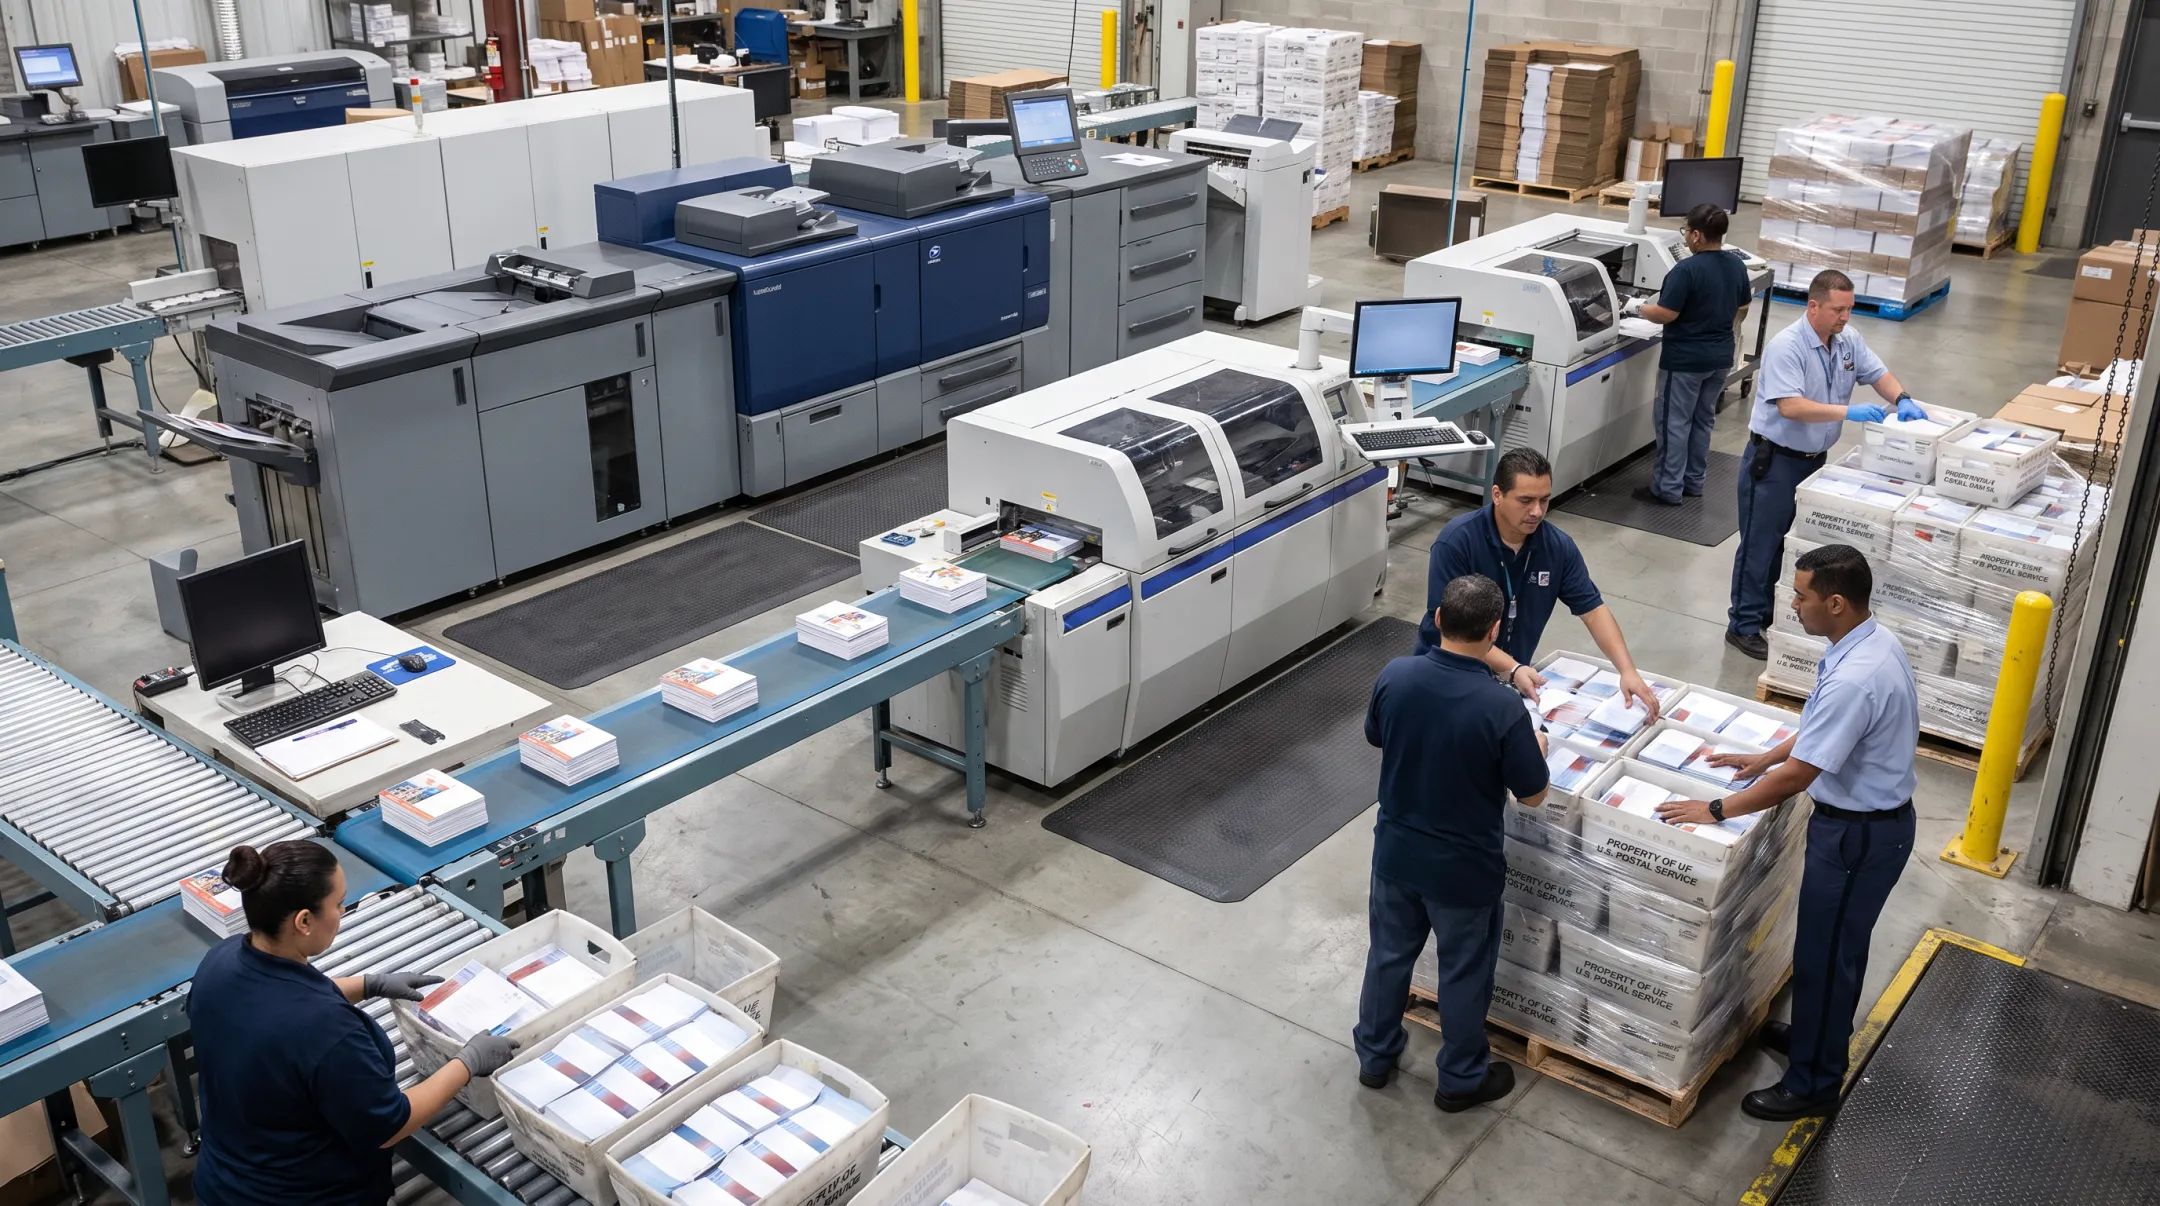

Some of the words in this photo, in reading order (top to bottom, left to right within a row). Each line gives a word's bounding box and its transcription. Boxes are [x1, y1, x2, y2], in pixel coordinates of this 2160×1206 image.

[1596, 844, 1613, 857] U.S.
[1615, 852, 1653, 871] POSTAL
[1655, 865, 1698, 886] SERVICE
[1606, 837, 1660, 862] PROPERTY
[1661, 857, 1677, 868] OF
[1677, 862, 1693, 873] UF
[1505, 867, 1543, 886] ROPERTY
[1543, 882, 1557, 892] OF
[1505, 877, 1534, 895] OSTAL
[1492, 985, 1526, 1002] PERTY
[1527, 999, 1541, 1008] OF
[1593, 974, 1630, 994] POSTAL
[1631, 989, 1674, 1011] SERVICE
[1637, 981, 1652, 991] OF
[1518, 1004, 1557, 1025] SERVICE
